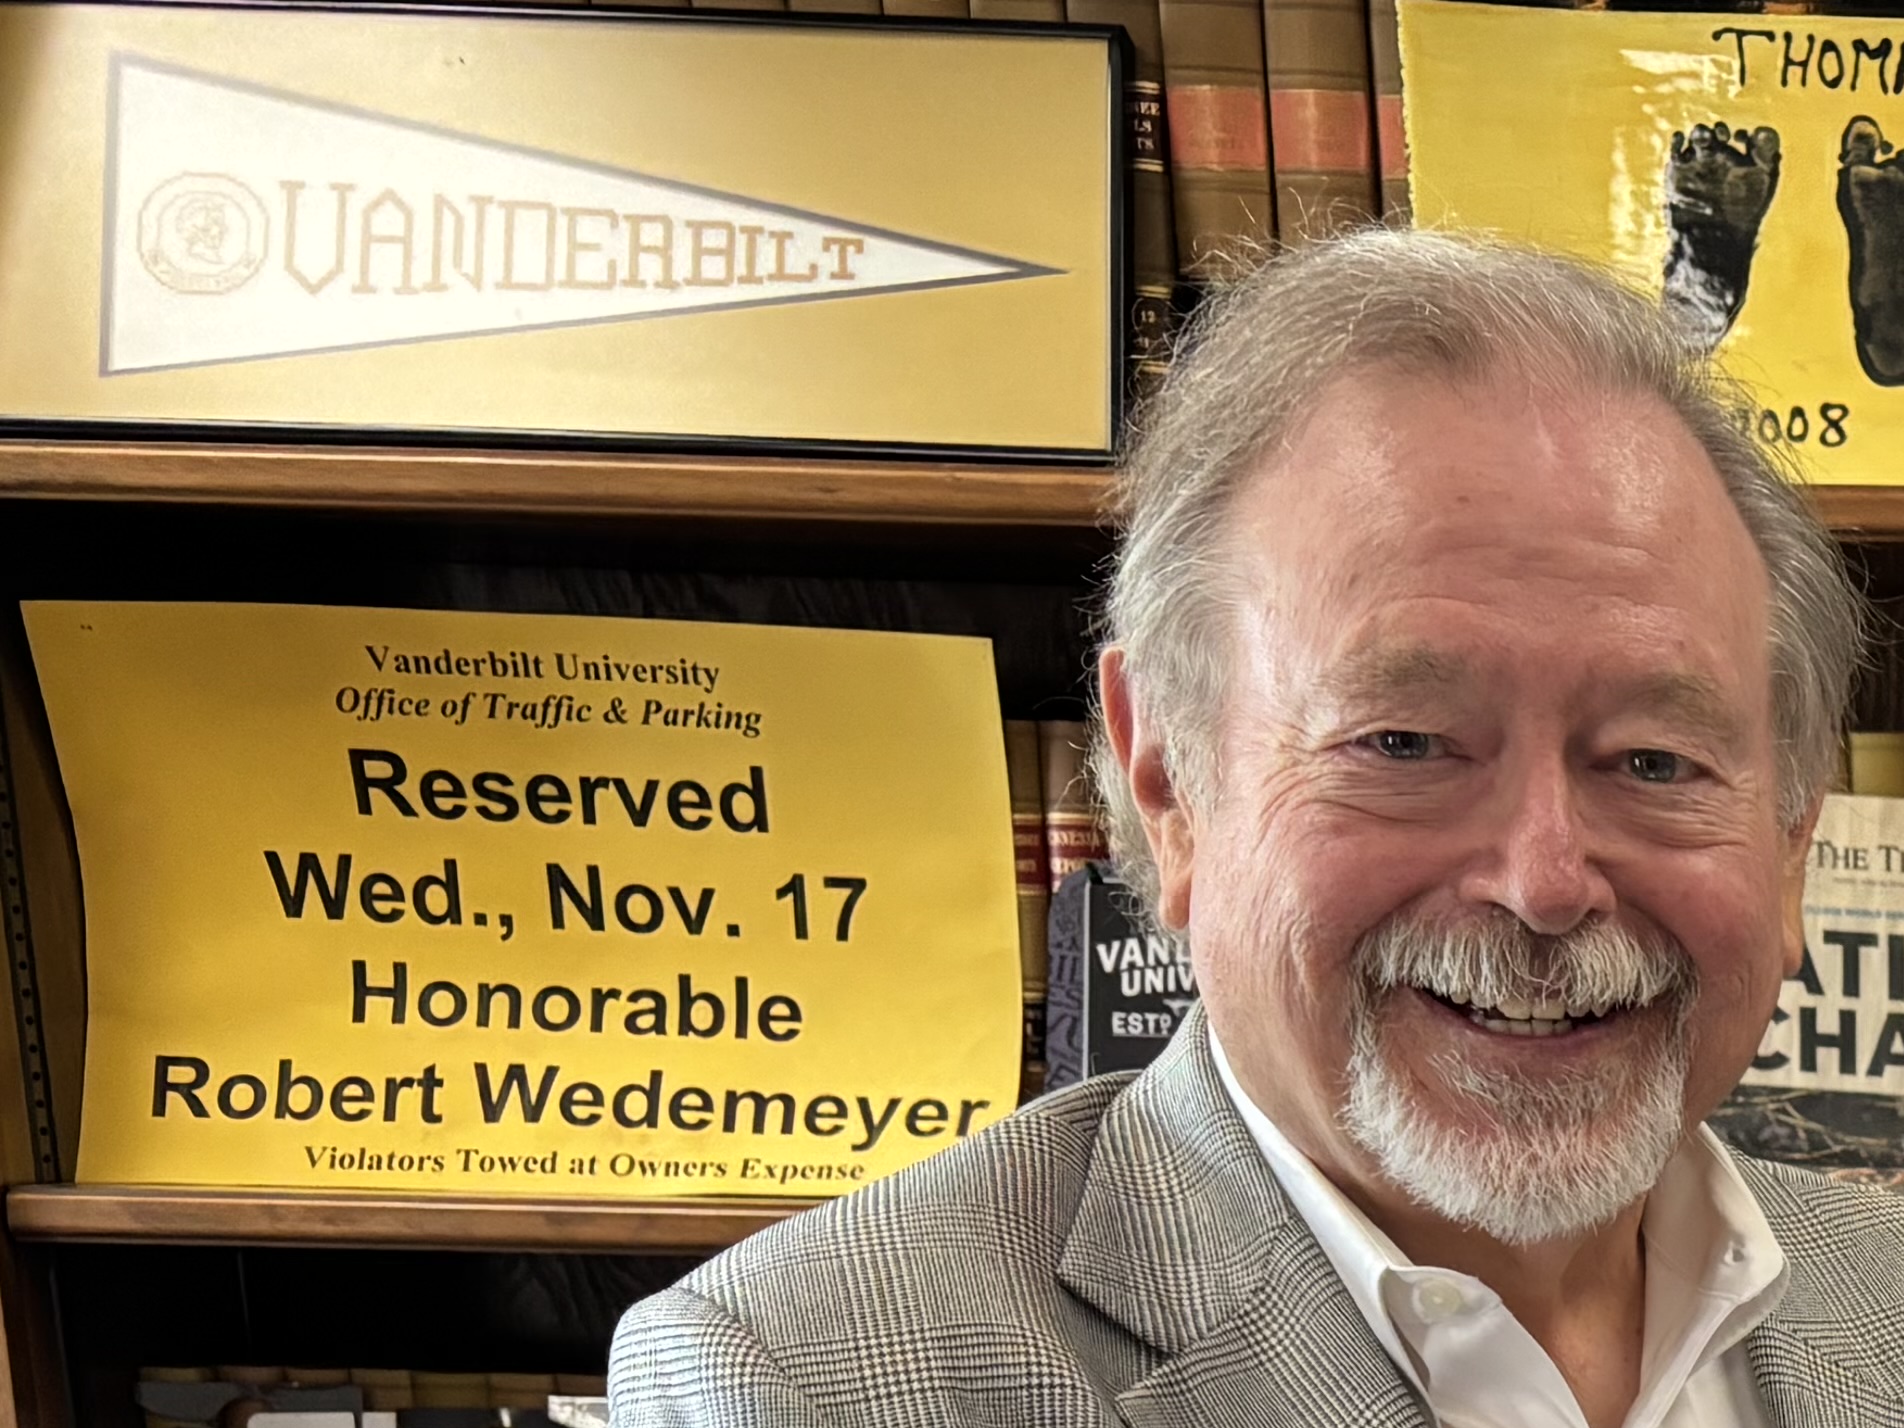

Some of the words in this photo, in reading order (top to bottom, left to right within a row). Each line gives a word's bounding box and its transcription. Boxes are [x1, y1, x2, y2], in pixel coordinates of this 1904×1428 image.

[279, 180, 865, 296] VANDERBILT
[365, 644, 545, 681] Vanderbilt
[554, 653, 720, 694] University
[334, 686, 432, 721] Office
[439, 689, 473, 725] of
[483, 691, 593, 729] Traffic
[602, 698, 630, 724] &
[641, 700, 762, 738] Parking
[348, 748, 770, 833] Reserved
[263, 851, 515, 942] Wed.,
[545, 861, 741, 938] Nov.
[774, 875, 867, 942] 17
[1813, 840, 1869, 871] THE
[351, 959, 804, 1042] Honorable
[151, 1054, 444, 1124] Robert
[473, 1061, 991, 1153] Wedemeyer
[303, 1144, 446, 1175] Violators
[455, 1147, 559, 1177] Towed
[568, 1152, 597, 1177] at
[609, 1152, 728, 1182] Owners
[740, 1154, 865, 1185] Expense
